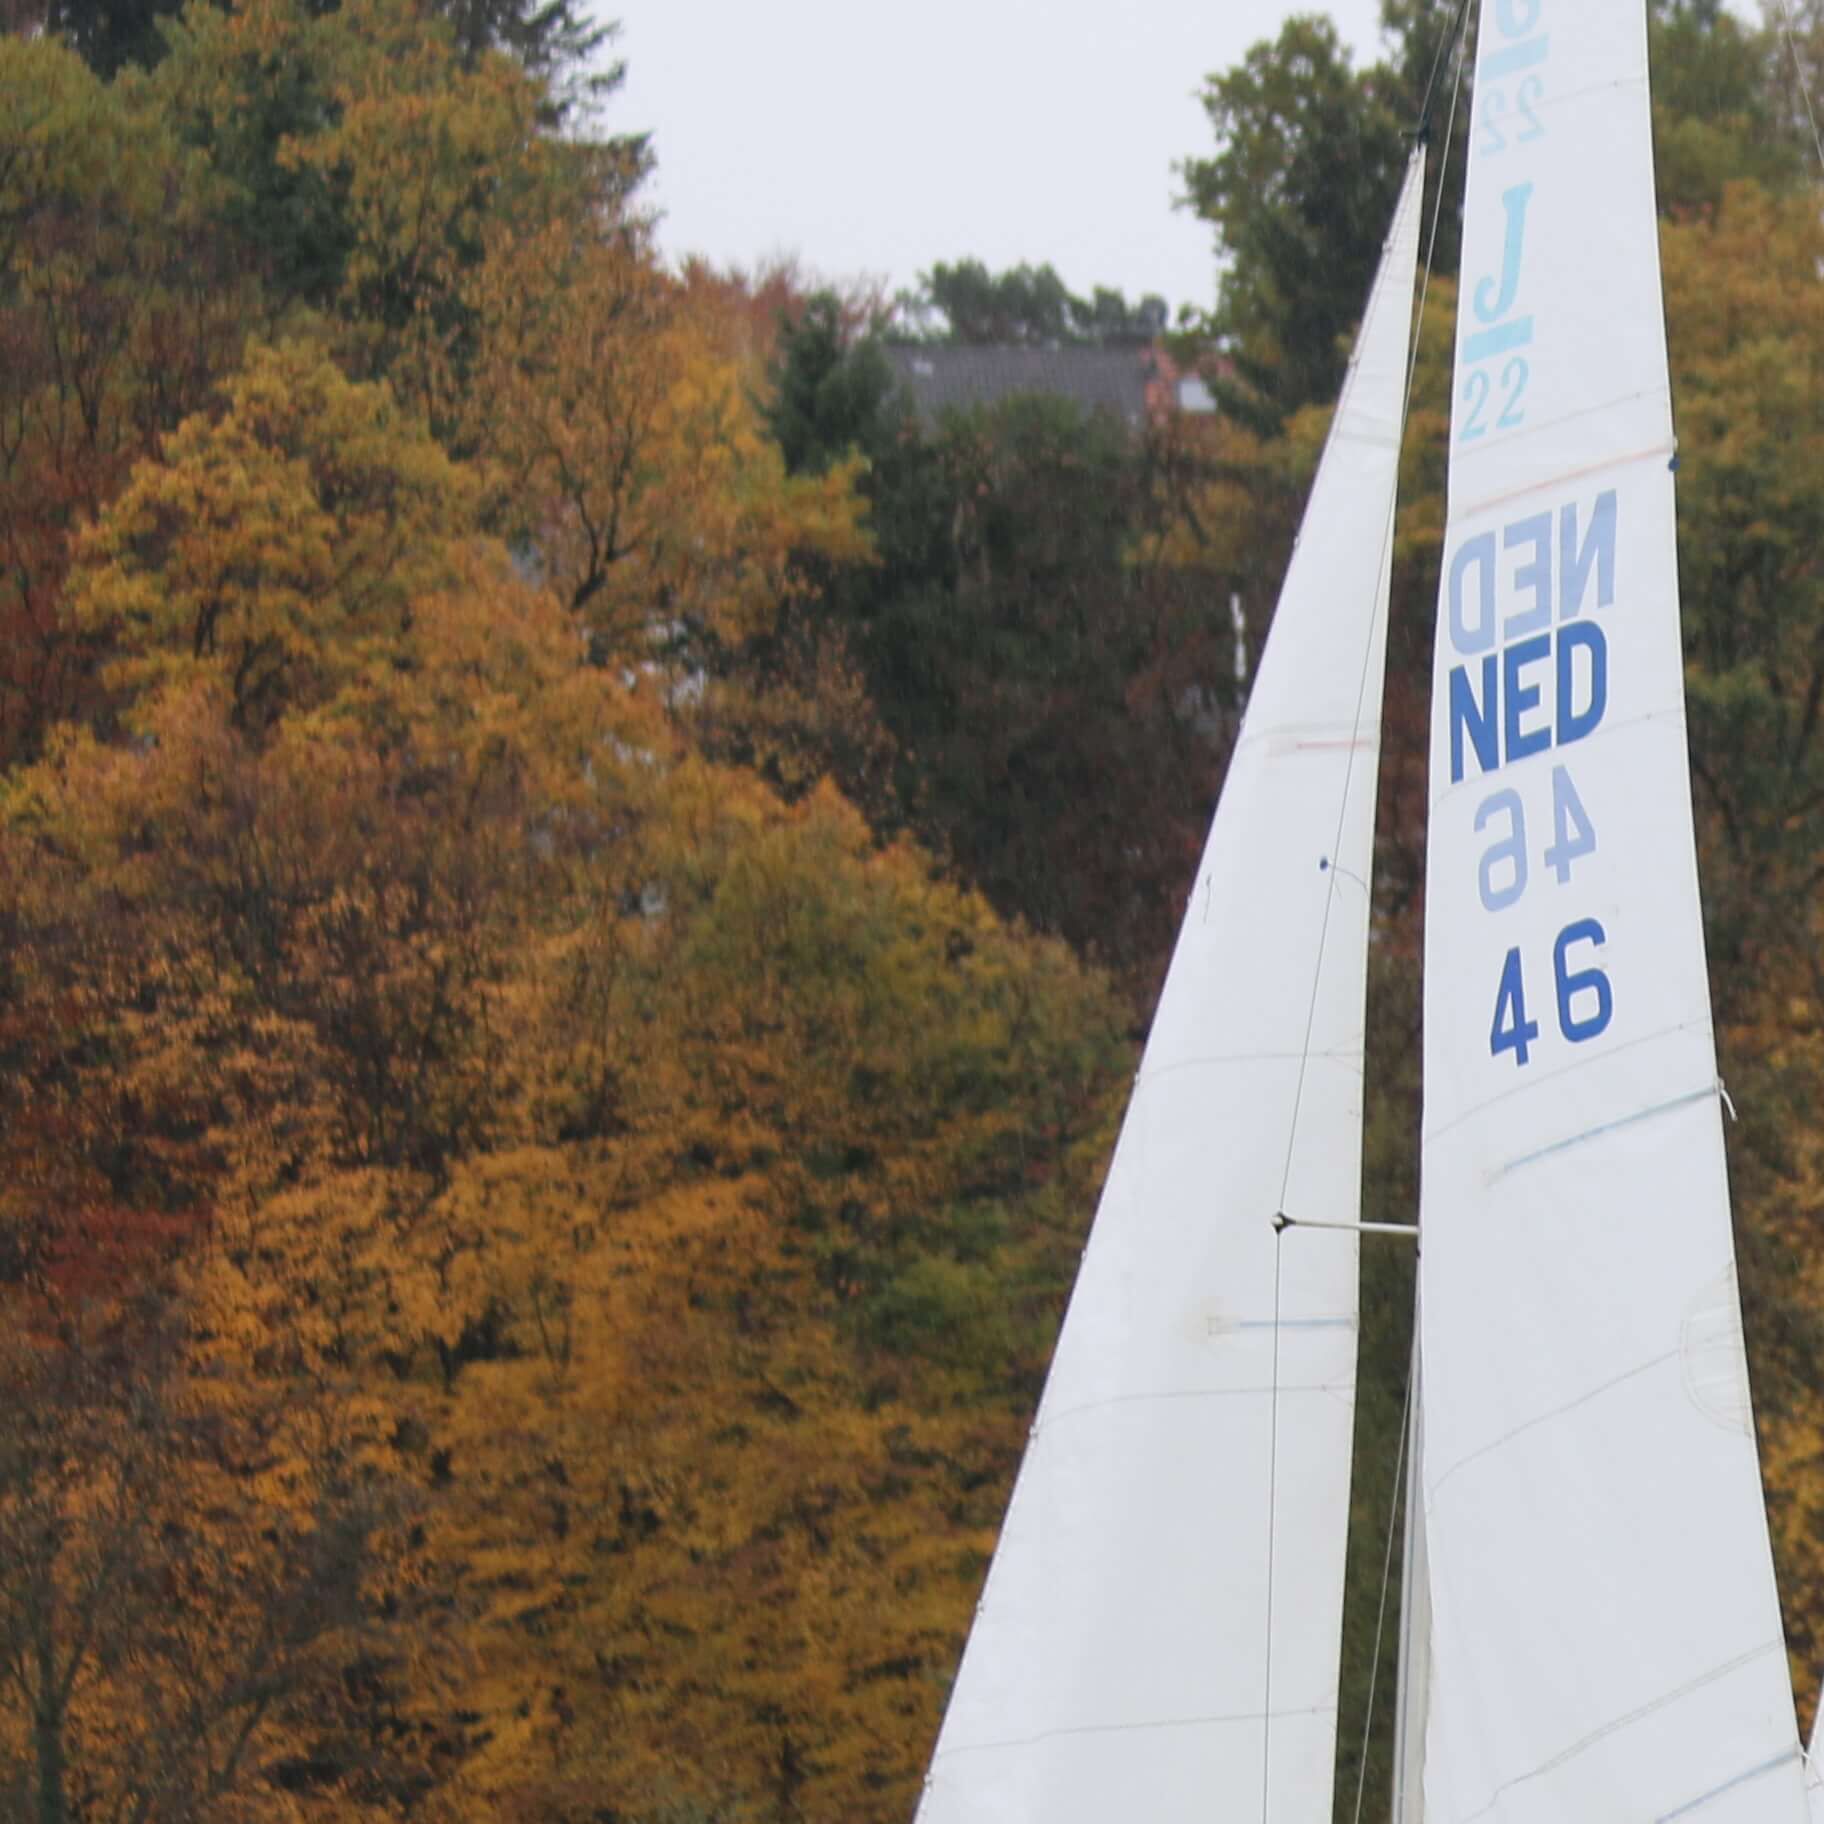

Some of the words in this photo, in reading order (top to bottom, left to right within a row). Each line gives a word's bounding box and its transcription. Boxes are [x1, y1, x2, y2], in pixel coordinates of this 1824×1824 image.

[1473, 181, 1534, 324] J
[1458, 356, 1530, 442] 22
[1449, 619, 1608, 784] NED
[1490, 917, 1614, 1067] 46
